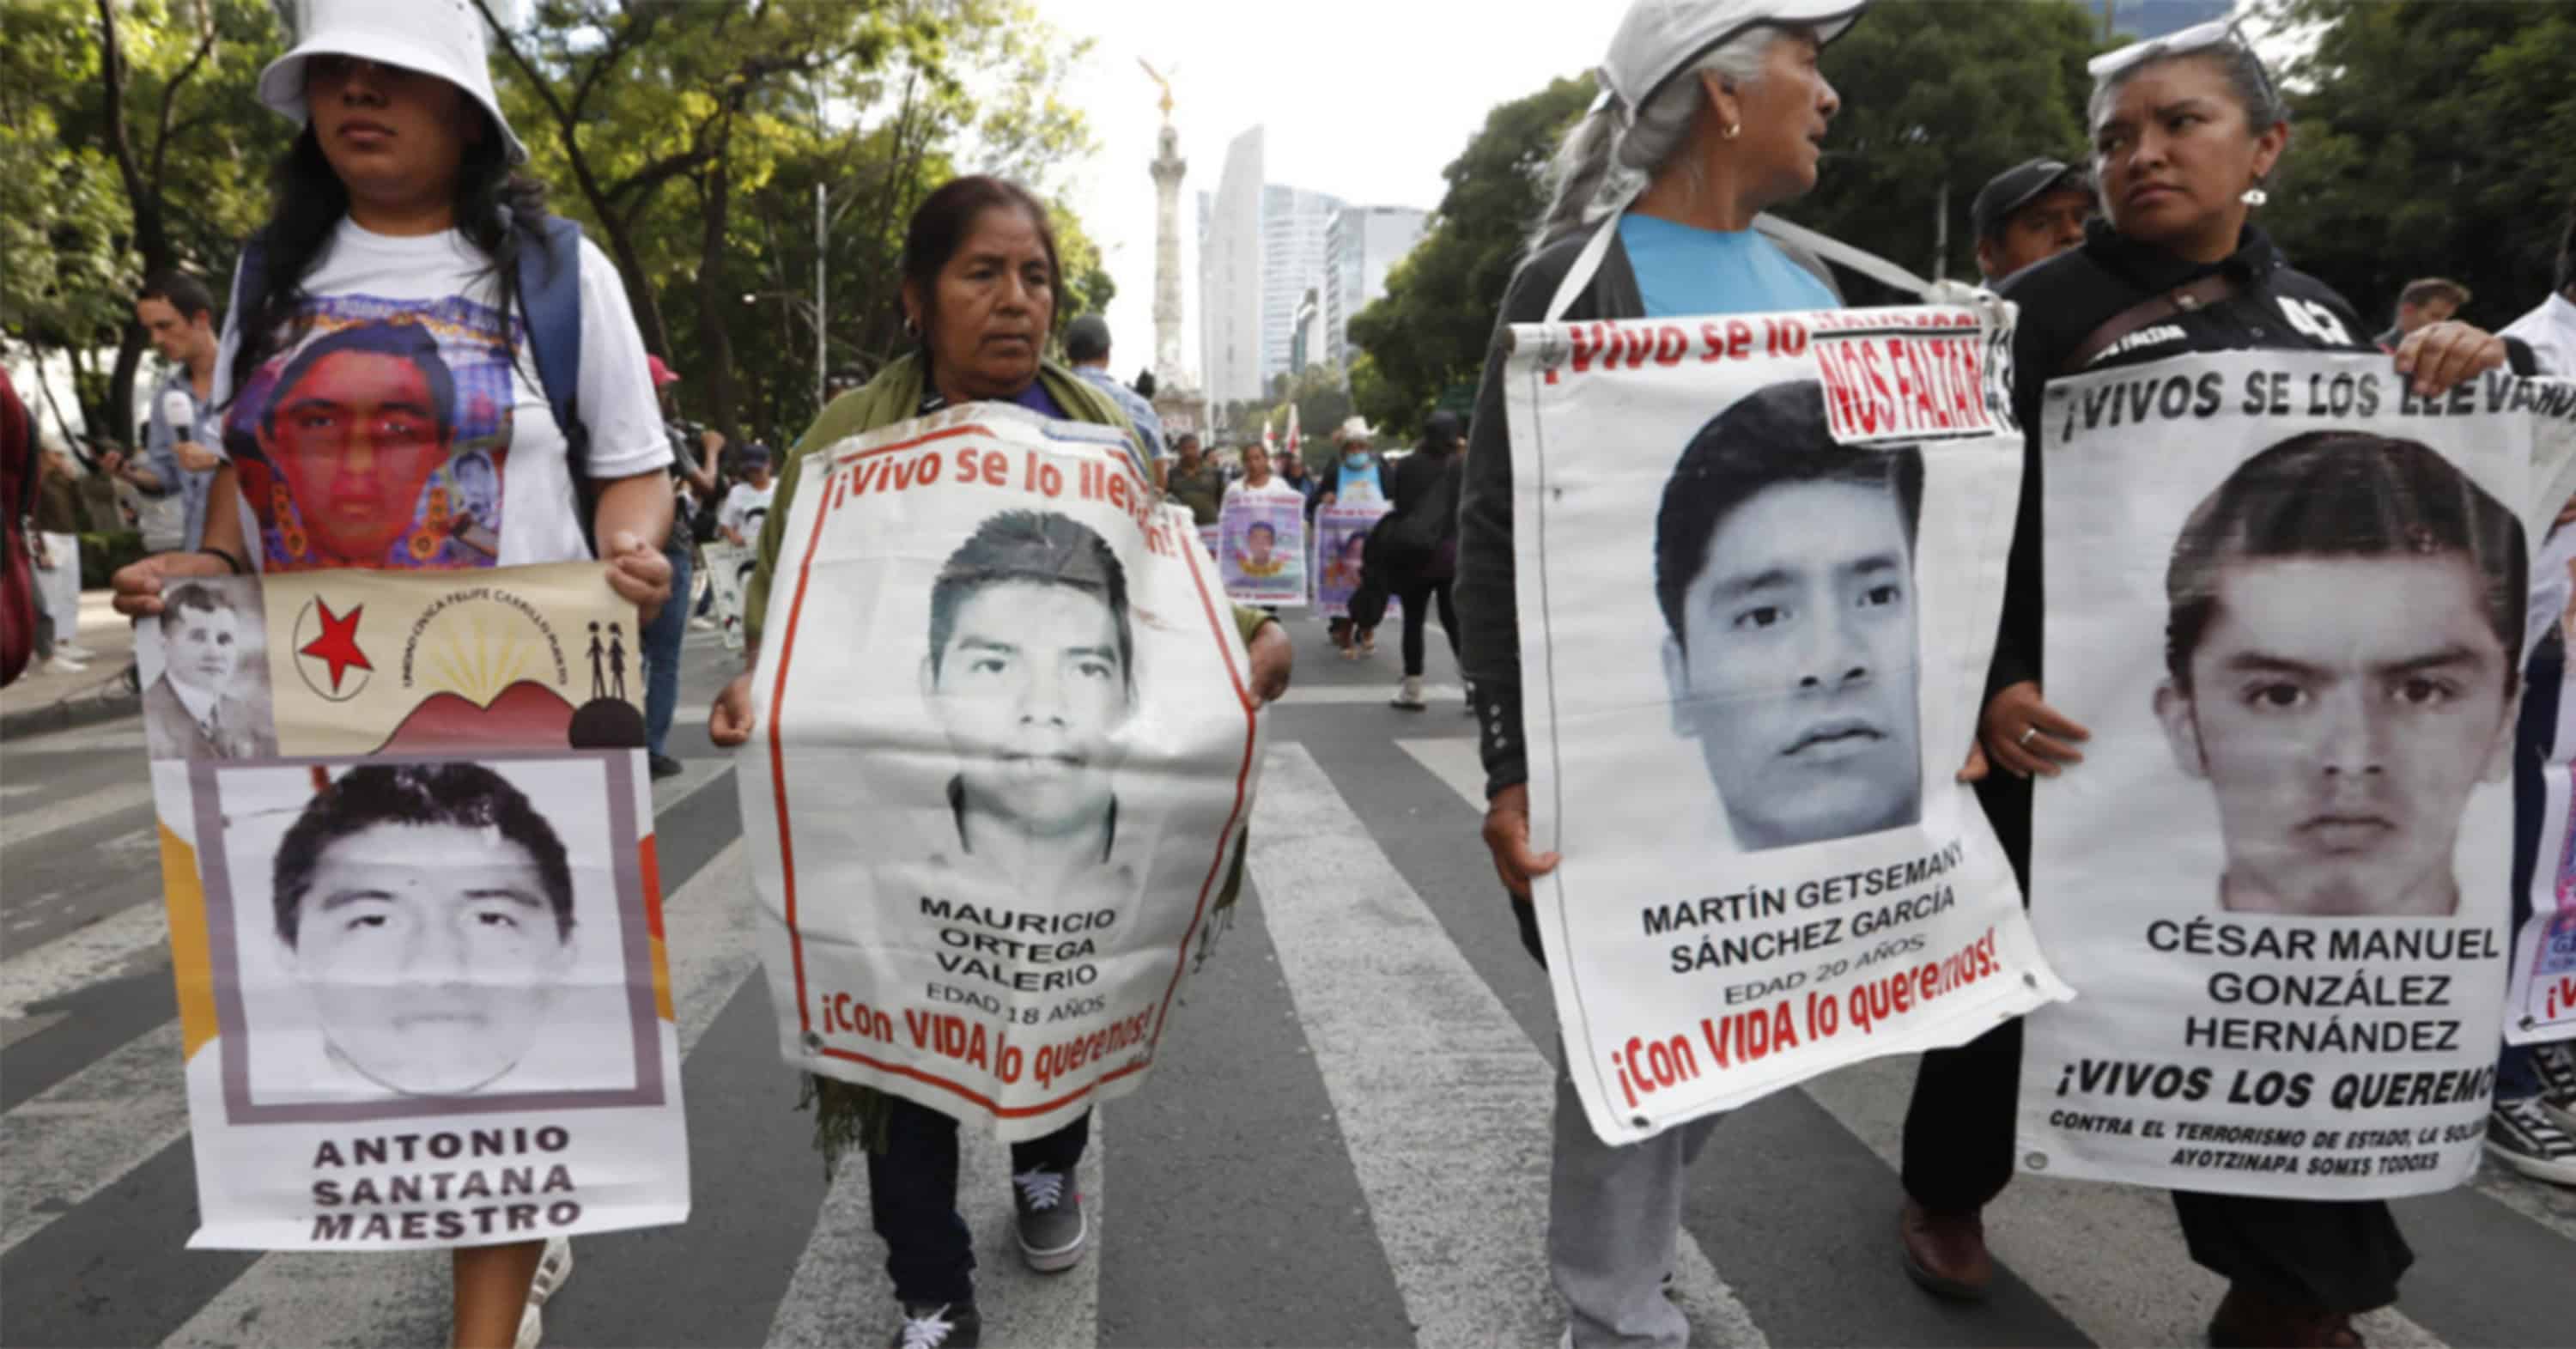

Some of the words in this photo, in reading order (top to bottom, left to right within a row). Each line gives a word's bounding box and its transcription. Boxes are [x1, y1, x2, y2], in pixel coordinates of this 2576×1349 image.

[1546, 319, 1688, 384] Vivo
[1698, 319, 1754, 363] se
[1814, 337, 1896, 436] NOS
[1886, 337, 1991, 431] FALTAN
[2063, 374, 2223, 443] ¡VIVOS
[2242, 370, 2290, 416] SE
[2307, 372, 2379, 417] LOS
[834, 451, 942, 509] ¡Vivo
[955, 447, 1009, 487] se
[1024, 451, 1063, 498] lo
[1642, 884, 1787, 936] MARTÍN
[1795, 839, 1965, 910] GETSEMANY
[920, 896, 1116, 935] MAURICIO
[1669, 918, 1843, 974] SÁNCHEZ
[1850, 885, 1955, 939] GARCÍA
[2146, 915, 2317, 961] CÉSAR
[2328, 927, 2500, 961] MANUEL
[939, 927, 1097, 963] ORTEGA
[935, 951, 1098, 992] VALERIO
[1724, 970, 1807, 1006] EDAD
[1816, 958, 1849, 983] 20
[1855, 933, 1926, 970] AÑOS
[2208, 969, 2451, 1006] GONZÁLEZ
[926, 982, 1000, 1015] EDAD
[1006, 1006, 1040, 1025] 18
[1047, 994, 1107, 1023] AÑOS
[1611, 1034, 1701, 1109] ¡Con
[1699, 1000, 1800, 1069] VIDA
[1806, 990, 1839, 1042] lo
[1849, 927, 2001, 1035] queremos!
[821, 991, 894, 1044] ¡Con
[904, 1008, 987, 1072] VIDA
[995, 1030, 1024, 1085] lo
[1033, 1002, 1156, 1090] queremos!
[2184, 1009, 2461, 1053] HERNÁNDEZ
[2057, 1059, 2213, 1101] ¡VIVOS
[2227, 1068, 2314, 1109] LOS
[313, 1126, 570, 1169] ANTONIO
[2049, 1109, 2134, 1136] CONTRA
[2140, 1120, 2166, 1139] EL
[2175, 1121, 2307, 1148] TERRORISMO
[2312, 1130, 2342, 1150] DE
[2417, 1127, 2440, 1145] LA
[2171, 1148, 2299, 1174] AYOTZINAPA
[312, 1164, 575, 1207] SANTANA
[310, 1200, 581, 1241] MAESTRO
